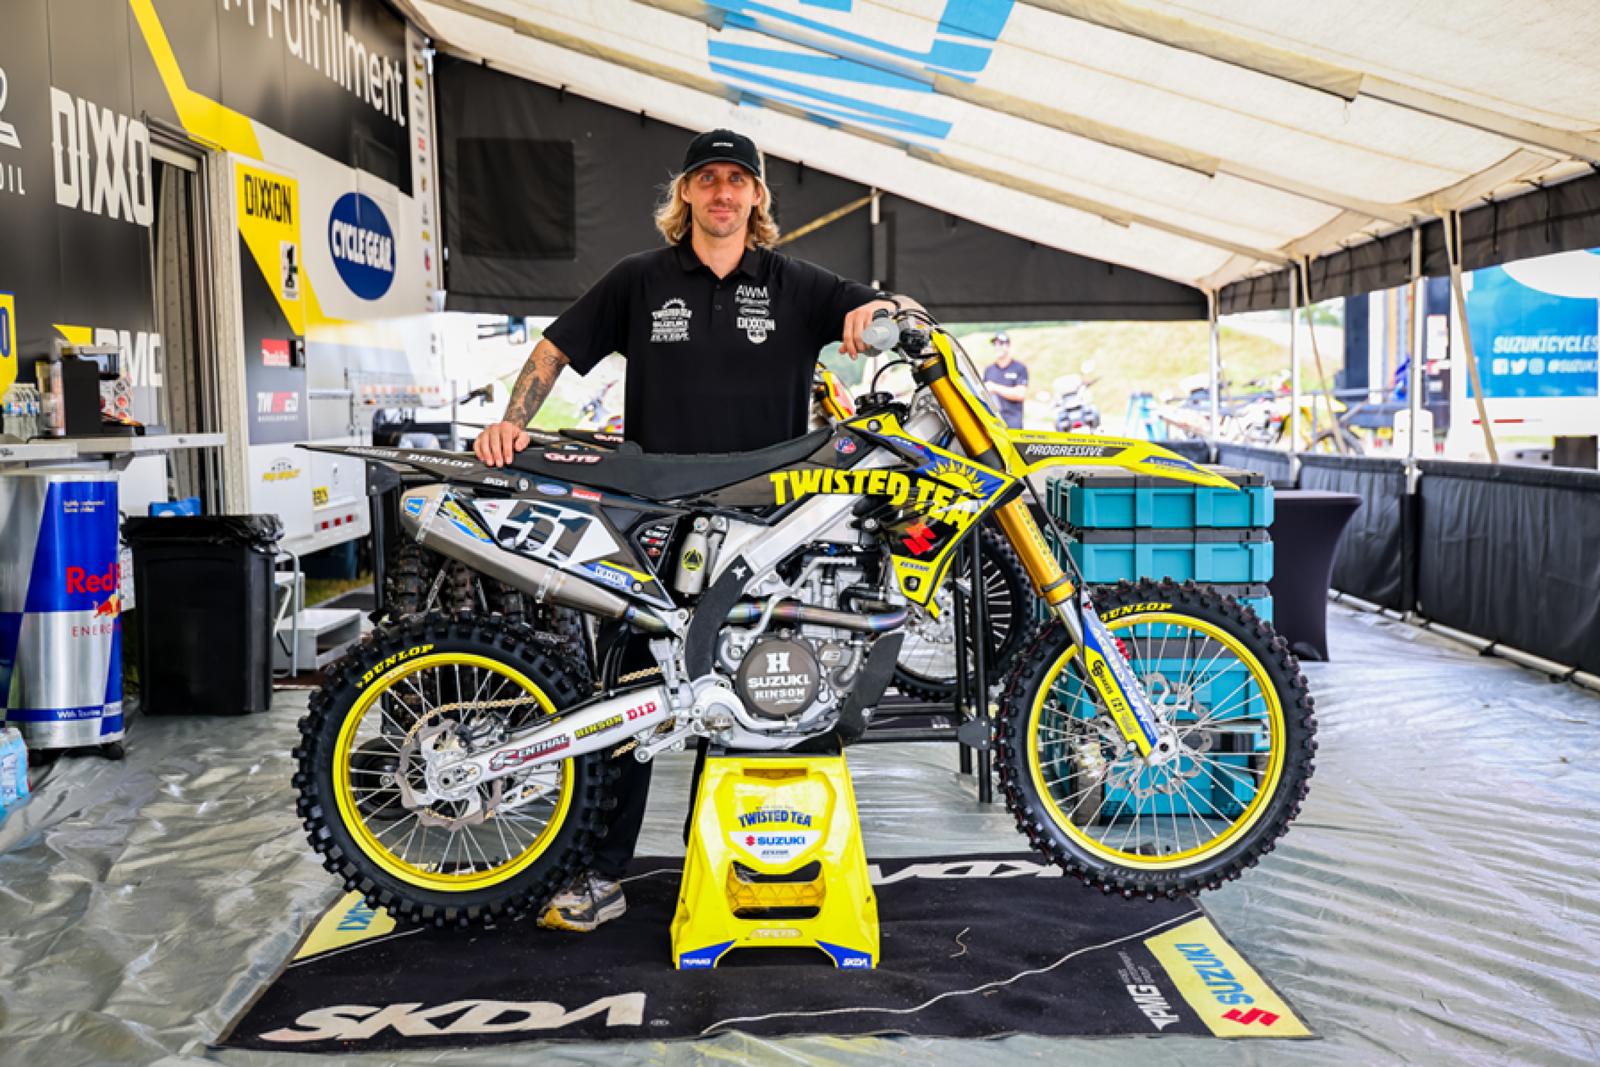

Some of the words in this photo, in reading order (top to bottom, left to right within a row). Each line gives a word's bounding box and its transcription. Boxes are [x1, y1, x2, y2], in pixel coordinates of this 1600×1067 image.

[0, 162, 25, 196] IL
[244, 172, 293, 225] DIXXON
[332, 219, 365, 265] CYCLE
[364, 228, 394, 273] GEAR
[1025, 443, 1107, 457] PROGRESSIVE
[770, 468, 911, 506] TWISTED
[914, 478, 973, 532] TEA
[66, 562, 114, 595] Red
[361, 643, 435, 684] DUNLOP
[747, 673, 813, 688] SUZUKI
[753, 688, 806, 700] HINSON
[575, 714, 624, 740] HINSON
[738, 810, 790, 828] TWISTED
[790, 811, 812, 828] TEA
[757, 836, 806, 846] SUZUKI
[1173, 943, 1256, 1006] SUZUKI
[258, 992, 647, 1042] SKDA
